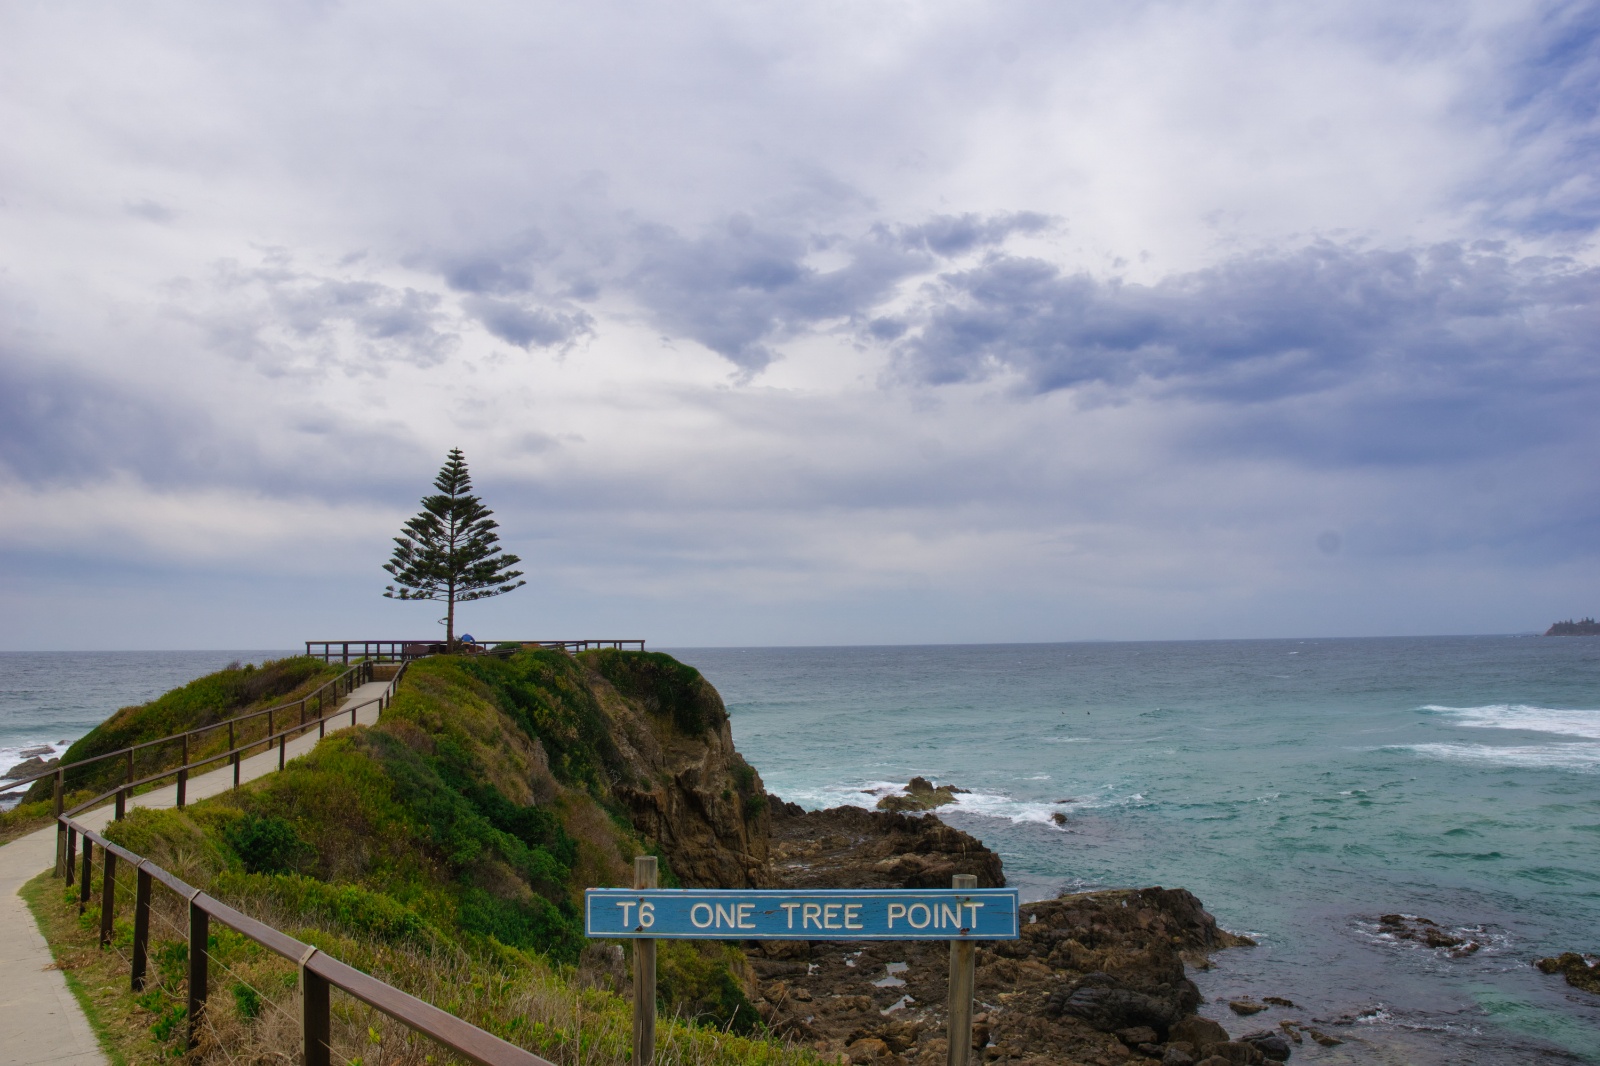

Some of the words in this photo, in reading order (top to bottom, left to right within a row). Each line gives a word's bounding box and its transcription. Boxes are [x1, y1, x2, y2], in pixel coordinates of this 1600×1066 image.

[616, 901, 655, 928] T6
[690, 903, 756, 929] ONE
[780, 903, 864, 930] TREE
[888, 903, 985, 929] POINT
